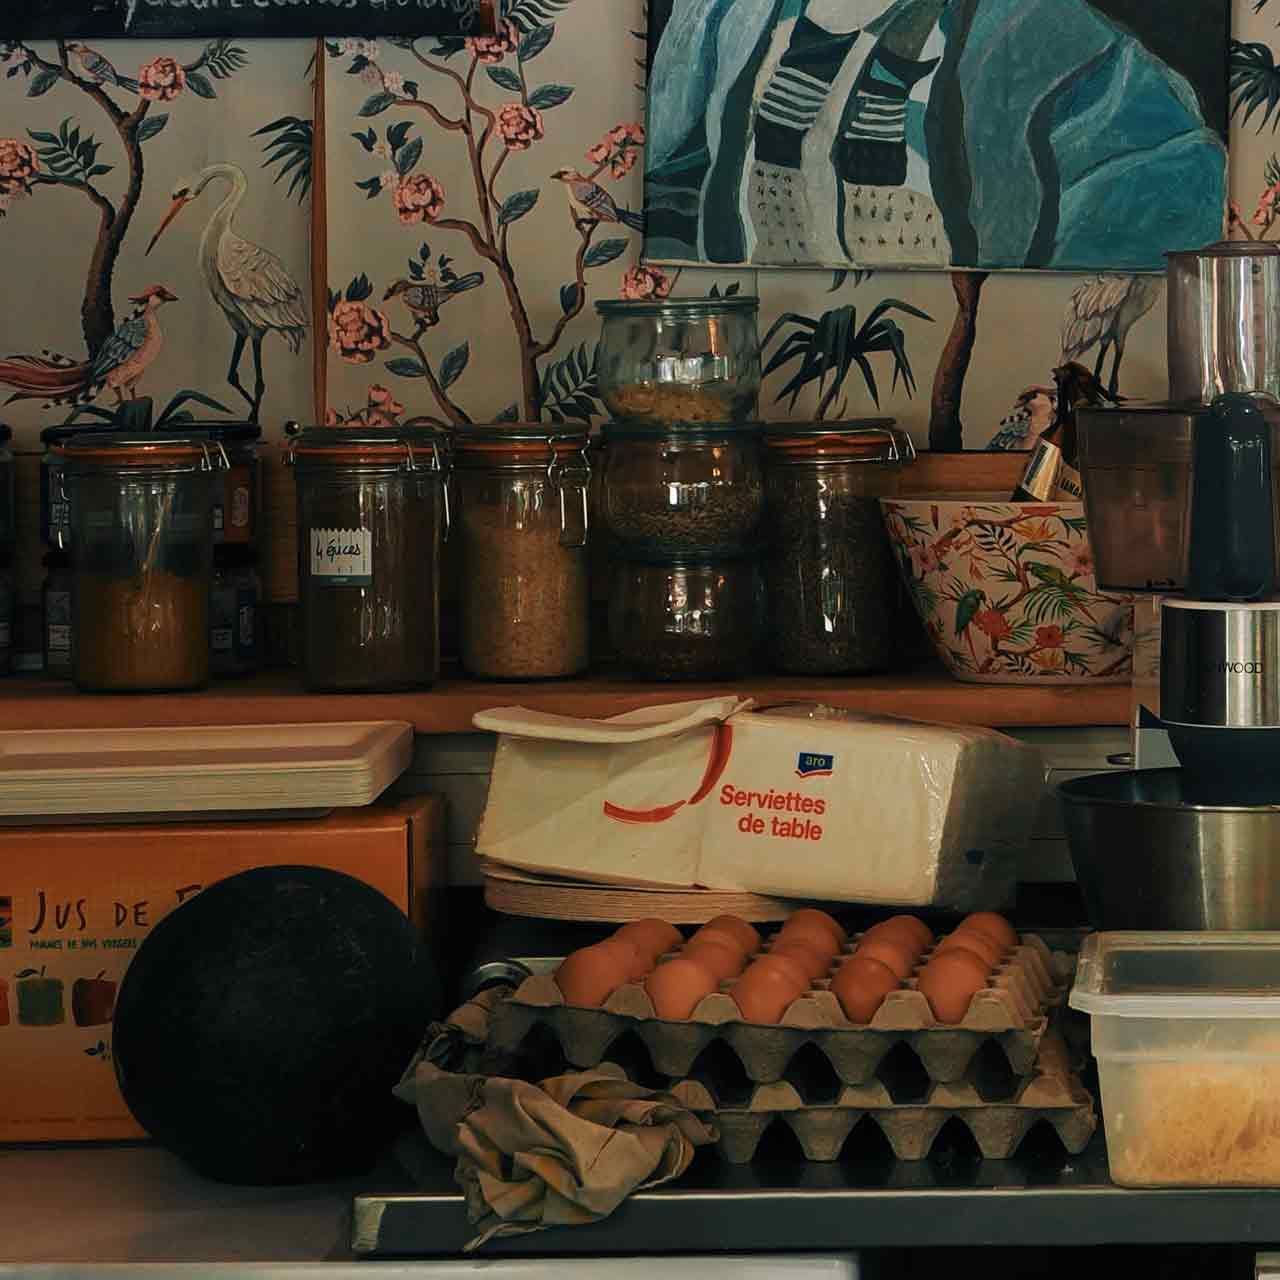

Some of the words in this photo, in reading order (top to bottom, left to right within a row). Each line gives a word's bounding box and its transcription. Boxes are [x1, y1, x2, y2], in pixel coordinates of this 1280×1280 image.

[315, 535, 323, 561] 4
[1217, 661, 1264, 675] WOOD
[805, 756, 826, 767] aro
[719, 783, 826, 816] Serviettes
[738, 813, 766, 835] de
[771, 816, 823, 841] table
[28, 890, 88, 934] JUS
[113, 900, 150, 928] DE
